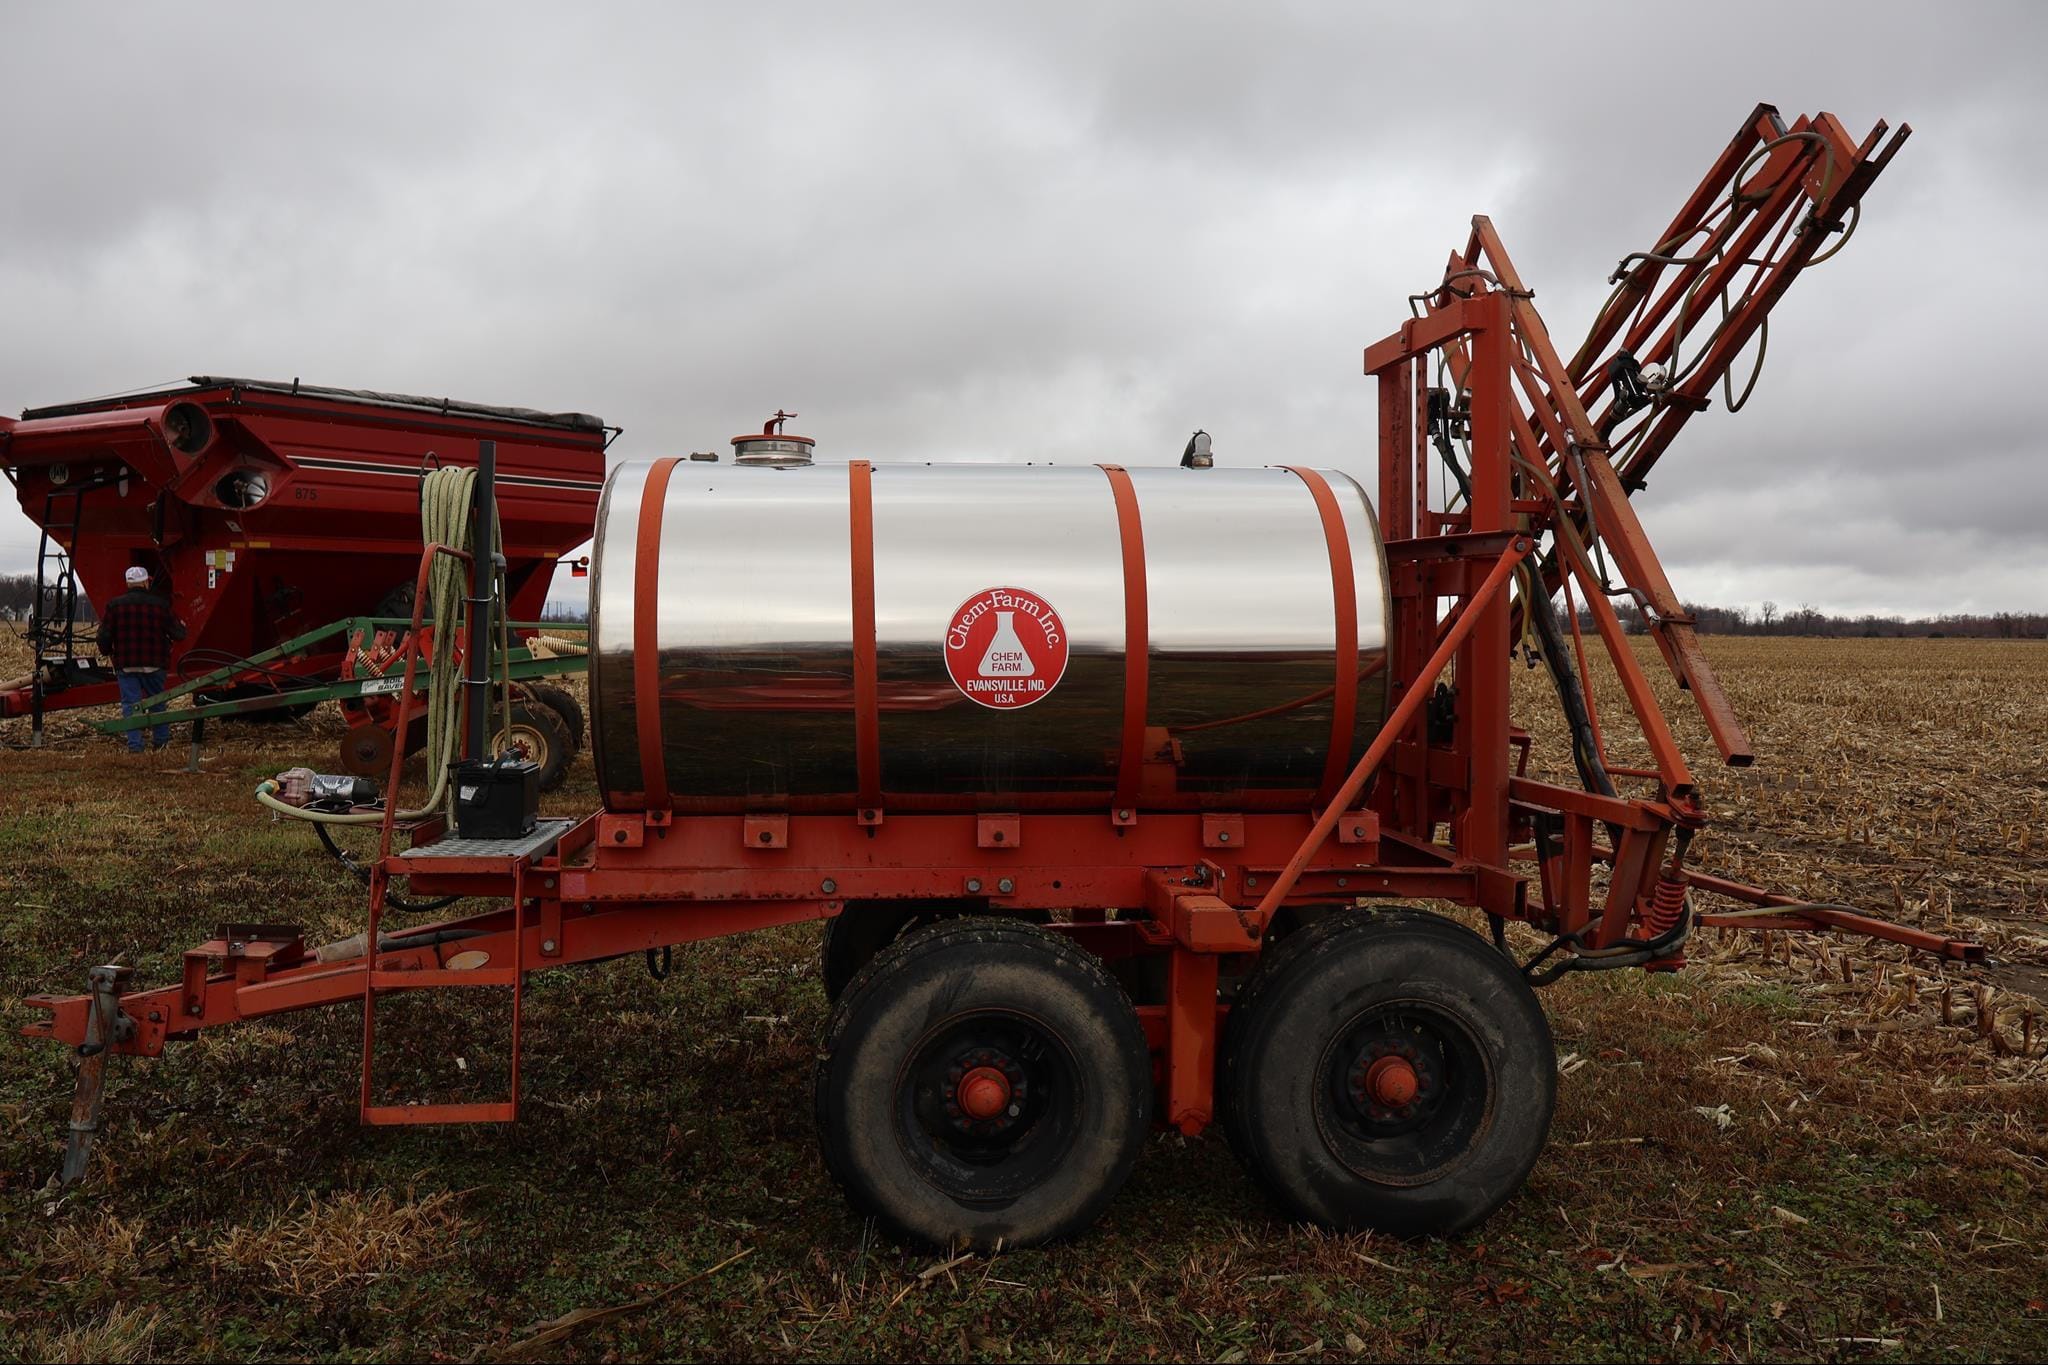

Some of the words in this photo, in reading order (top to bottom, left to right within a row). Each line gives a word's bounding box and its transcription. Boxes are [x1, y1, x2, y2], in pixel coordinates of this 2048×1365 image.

[295, 488, 318, 501] 875
[948, 590, 1040, 650] Chem-Farm
[1037, 610, 1060, 649] Inc.
[991, 652, 1023, 661] CHEM
[967, 680, 1027, 692] EVANSVILLE,
[1028, 680, 1046, 691] IND.
